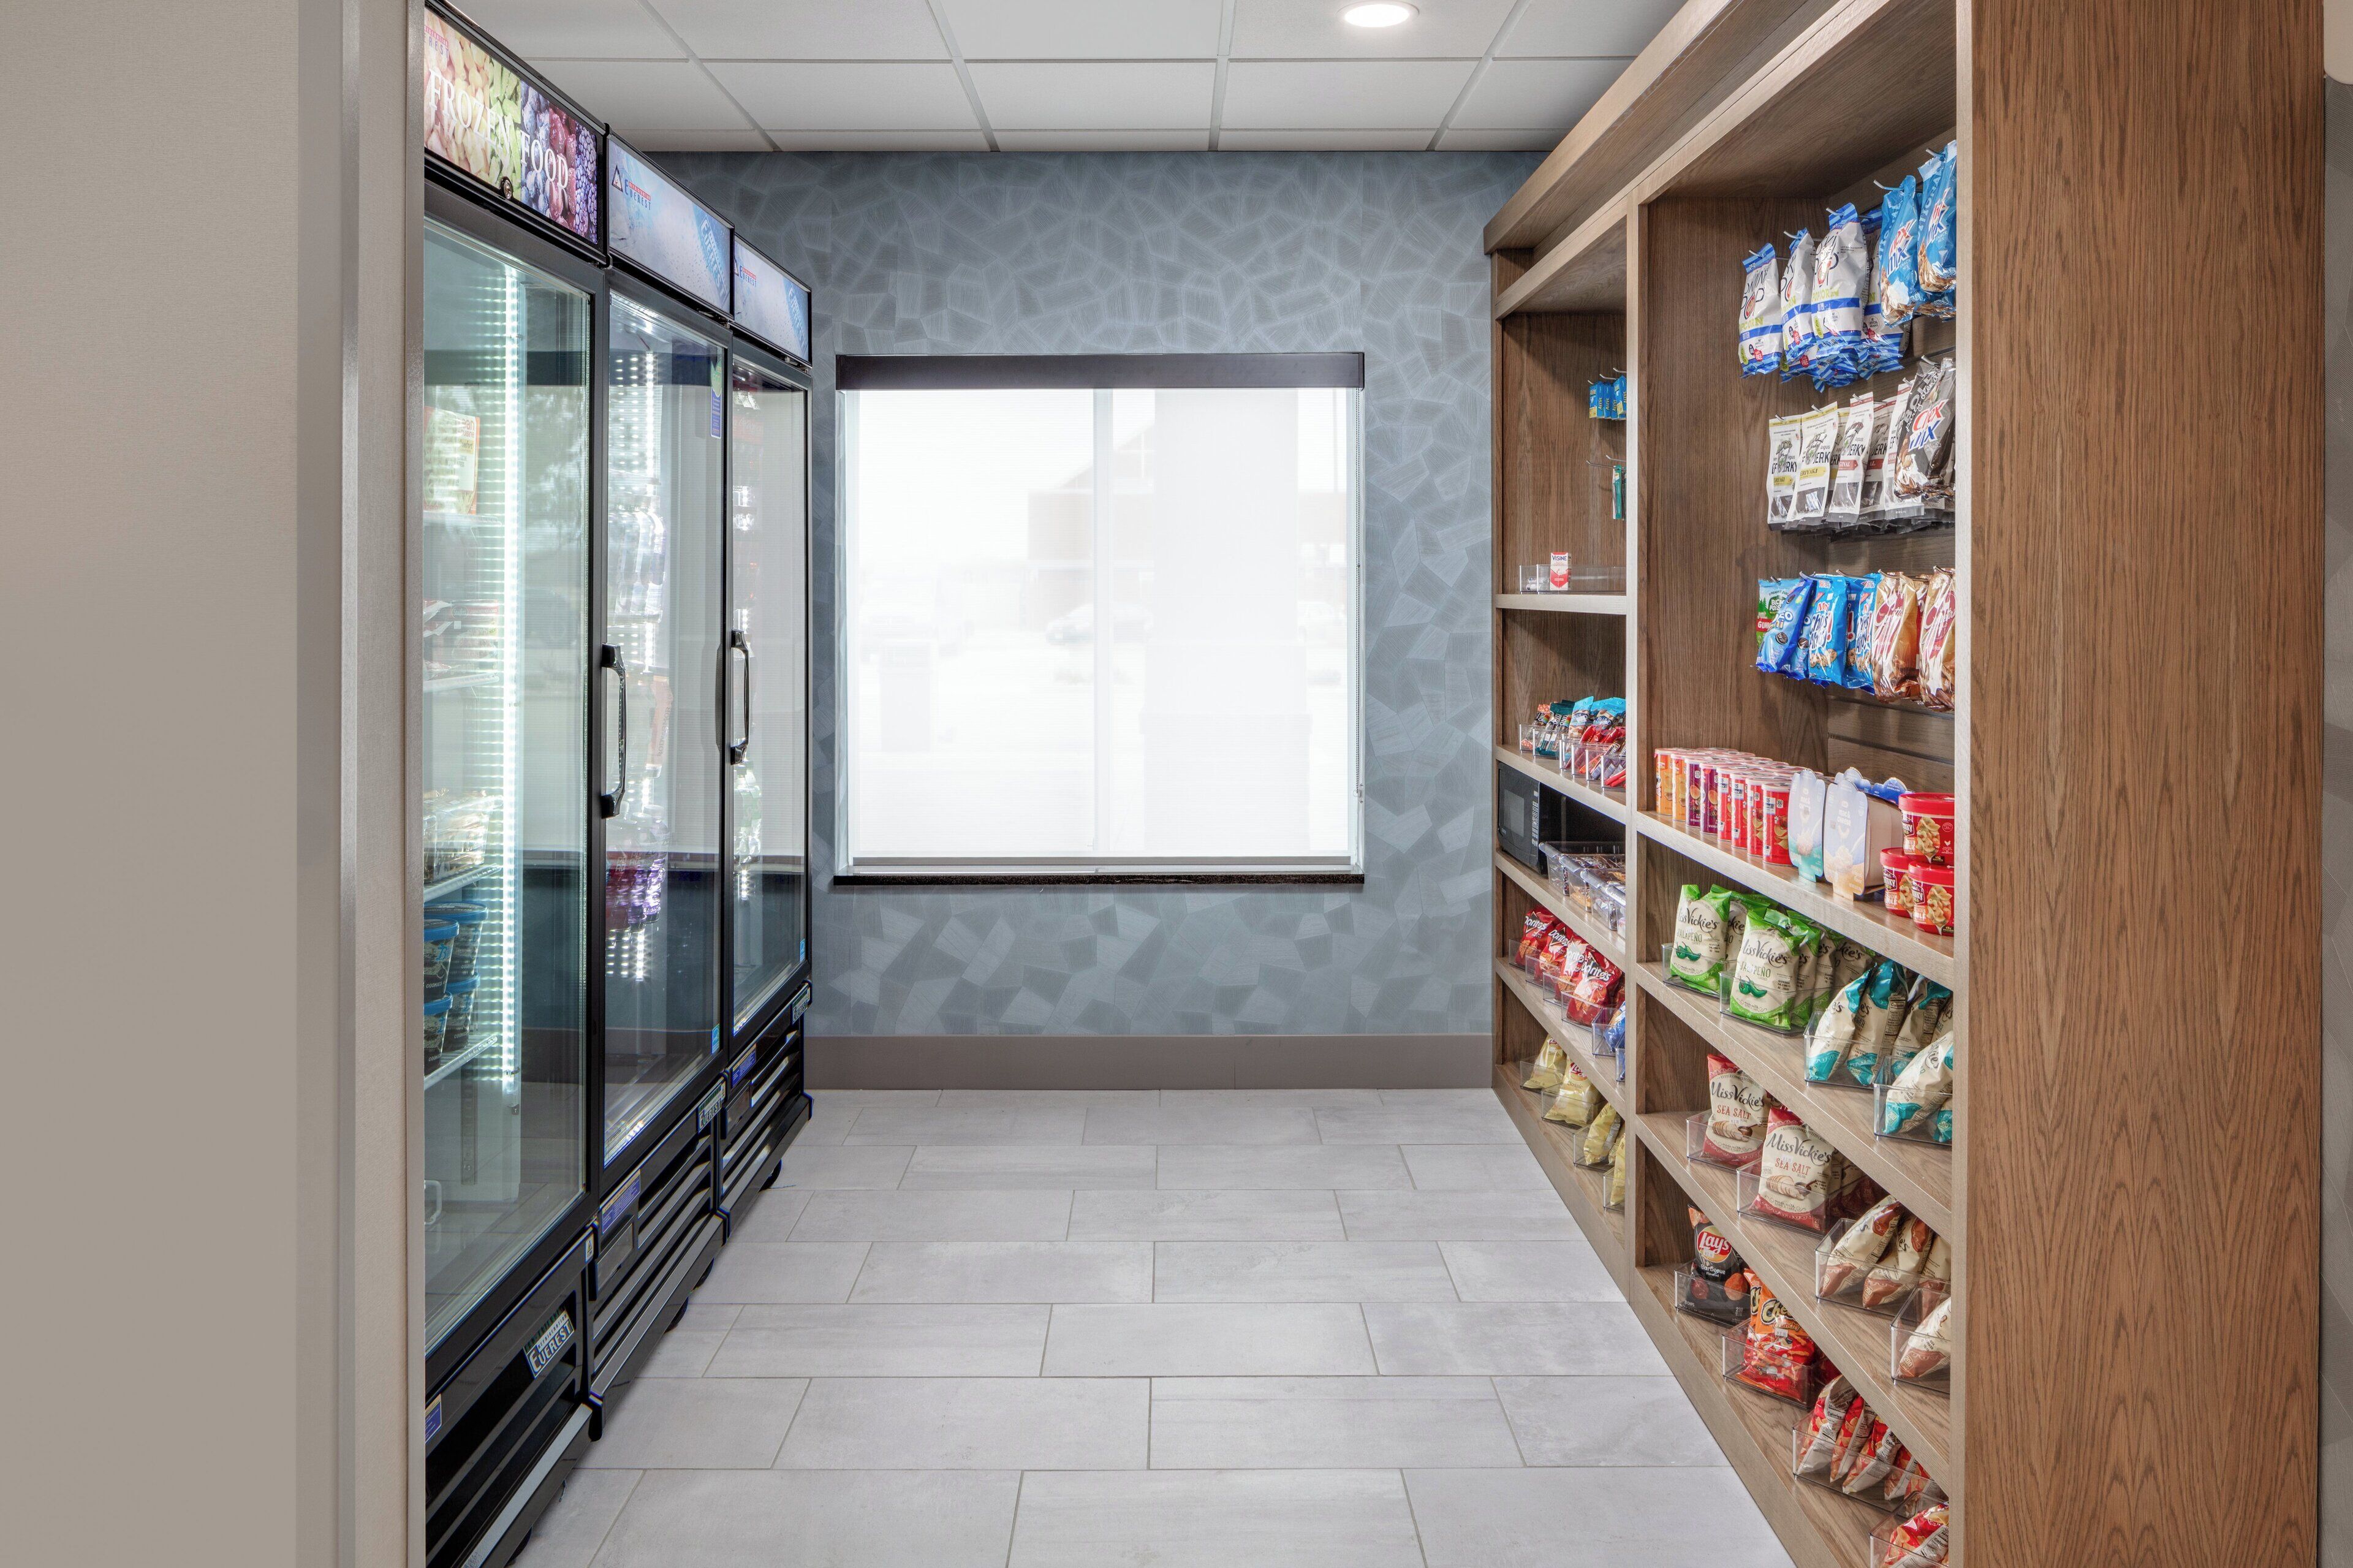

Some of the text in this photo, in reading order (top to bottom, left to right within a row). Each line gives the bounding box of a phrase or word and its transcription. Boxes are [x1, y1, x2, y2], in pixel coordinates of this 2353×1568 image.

[429, 68, 569, 189] FROZEN FOOD
[624, 179, 651, 210] EVEREST
[1913, 401, 1945, 433] Chex
[1686, 907, 1719, 933] Vickie's
[1548, 929, 1570, 947] Doritos
[1677, 928, 1702, 943] JALAPEÑO
[1757, 940, 1789, 968] Vickie's
[1710, 1081, 1765, 1112] Miss Vickie's
[700, 1099, 722, 1129] EVEREST
[1716, 1104, 1751, 1120] SEA SALT
[1766, 1133, 1833, 1167] Miss Vickie's
[1775, 1157, 1811, 1176] SEA SALT
[529, 1320, 572, 1373] EVEREST
[1827, 1411, 1843, 1420] Calories
